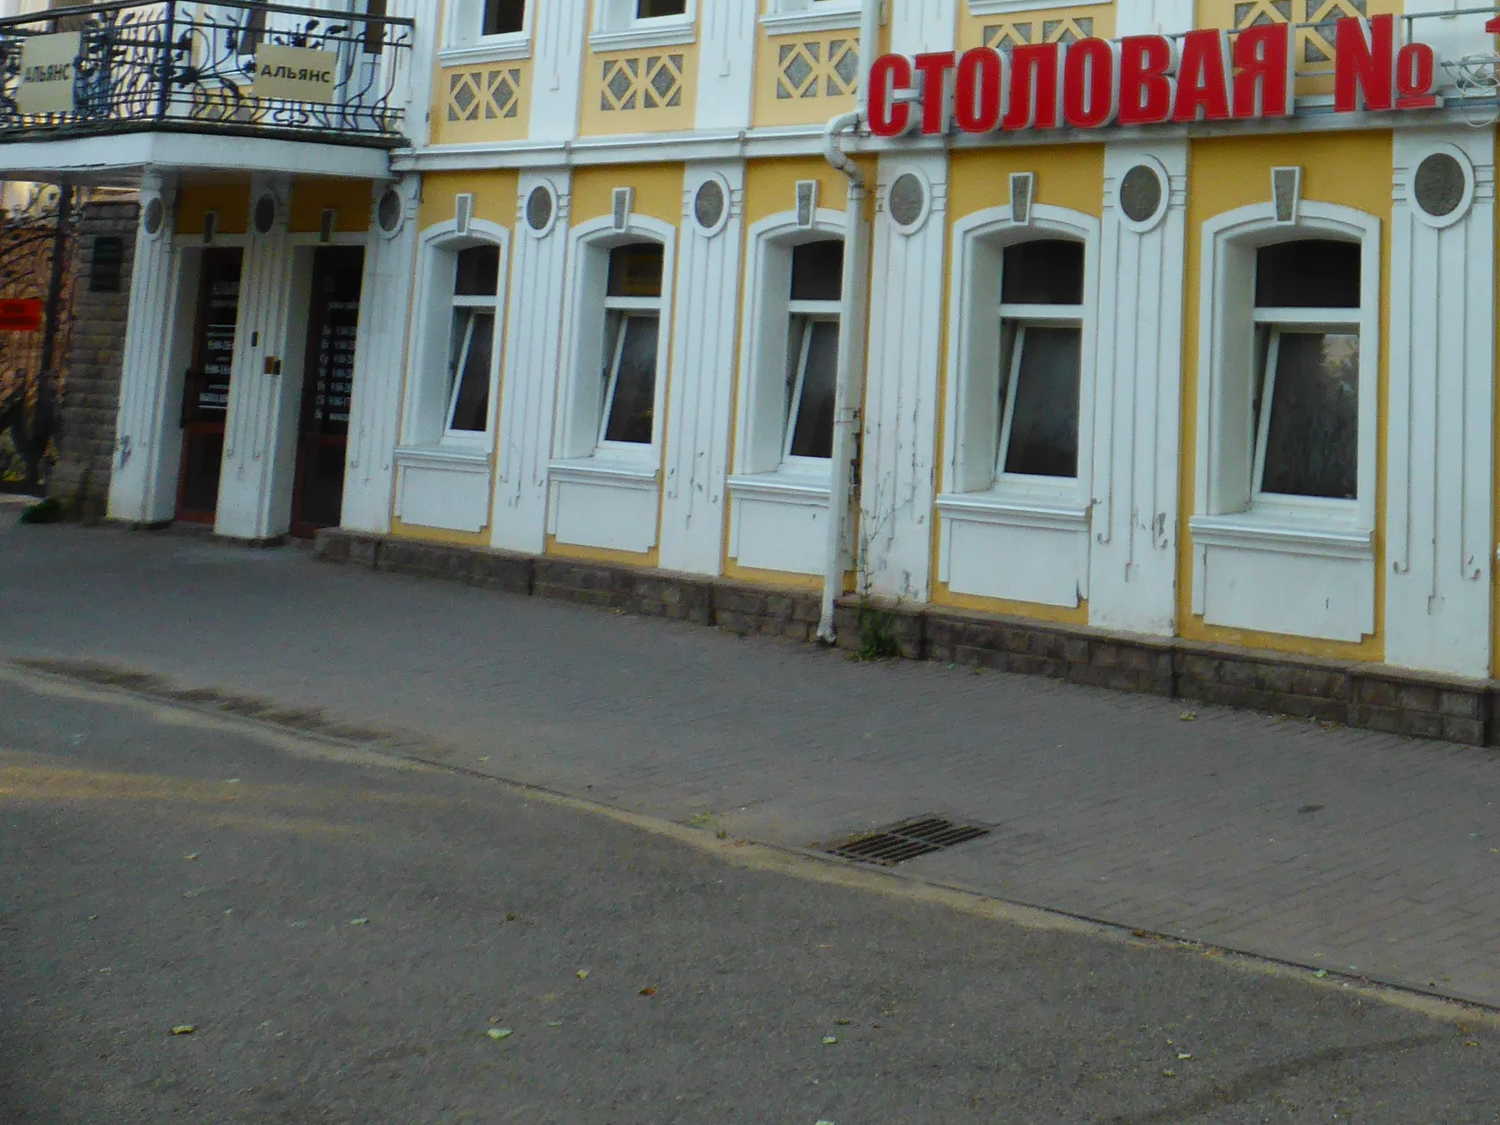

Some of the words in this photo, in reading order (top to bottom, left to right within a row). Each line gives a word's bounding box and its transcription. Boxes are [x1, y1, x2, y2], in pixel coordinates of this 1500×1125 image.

[24, 62, 72, 83] АЛЬЯНС
[261, 64, 331, 83] АЛЬЯНС
[867, 23, 1290, 137] СТОЛОВАЯ
